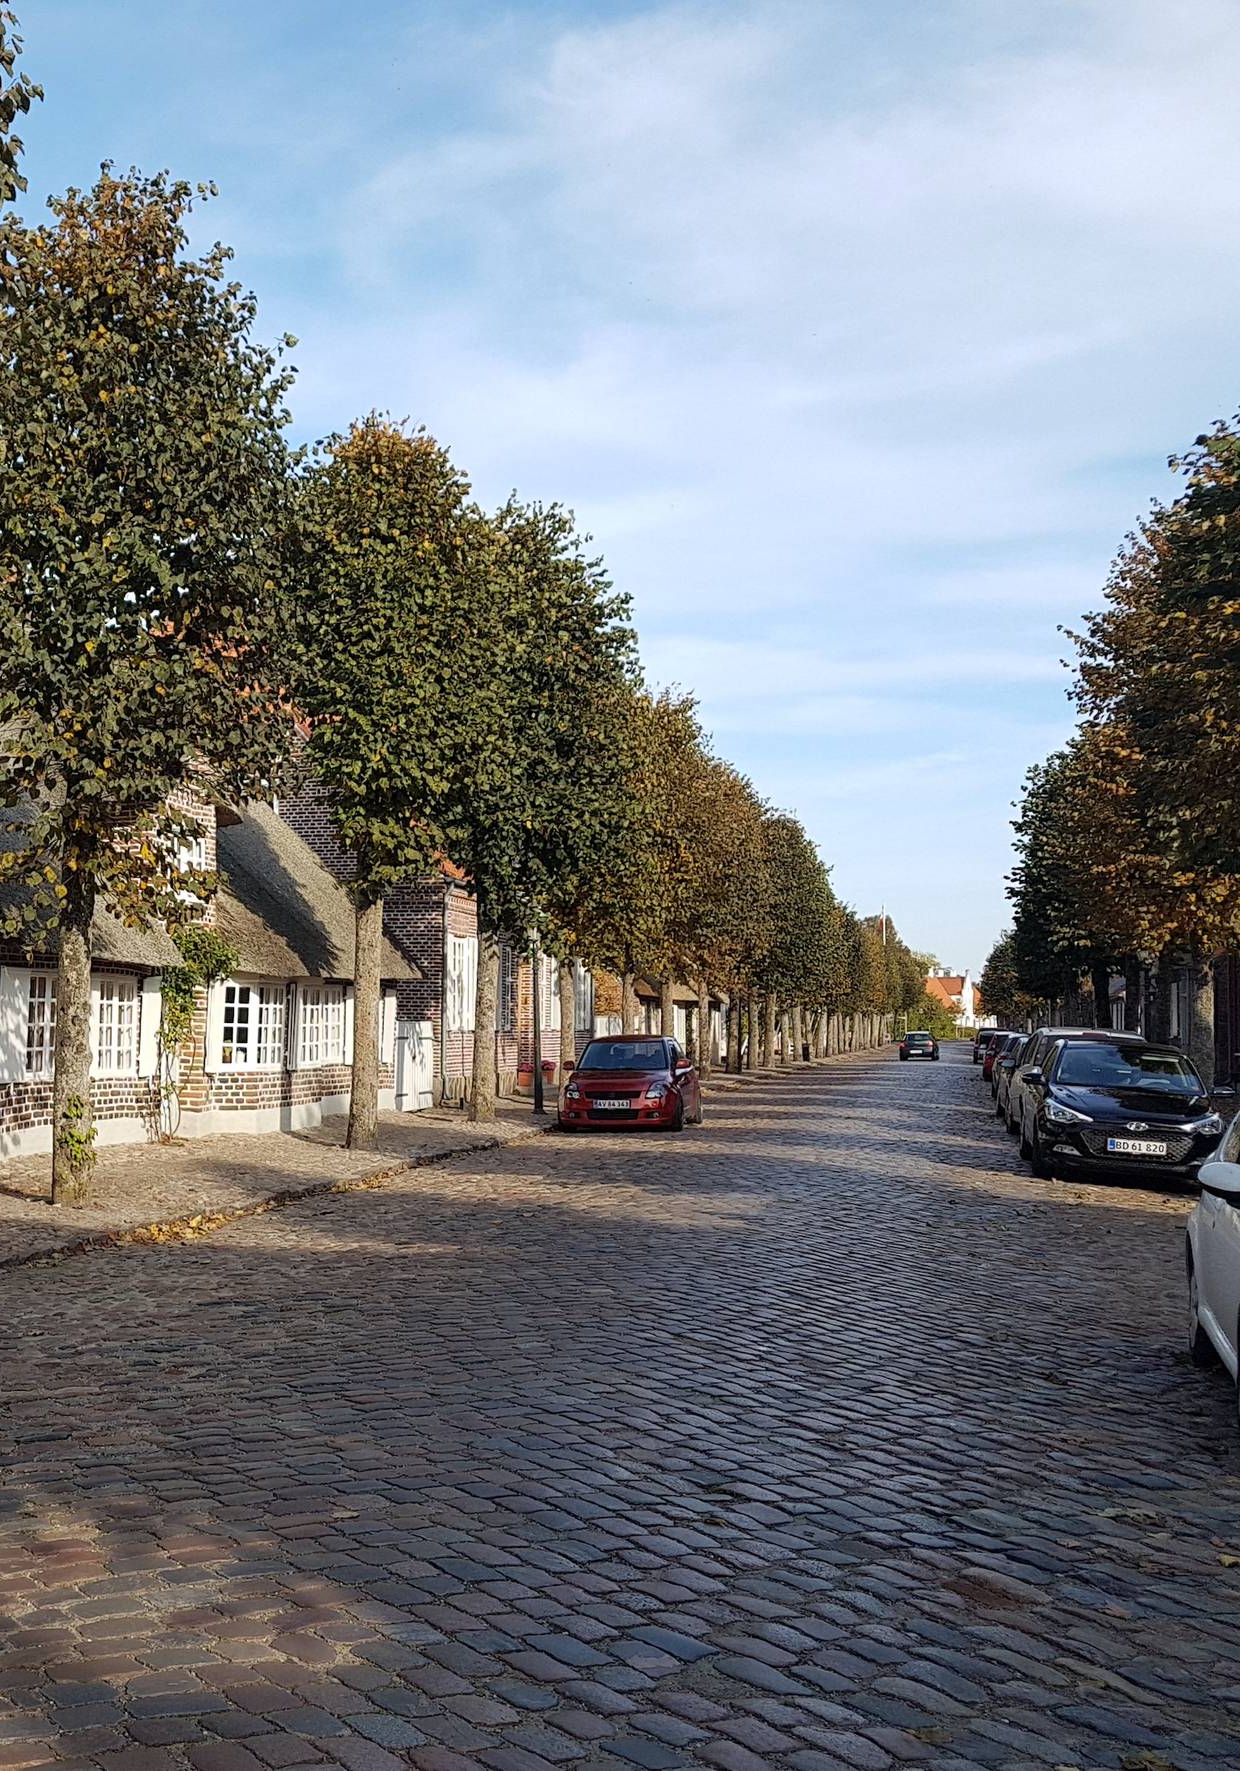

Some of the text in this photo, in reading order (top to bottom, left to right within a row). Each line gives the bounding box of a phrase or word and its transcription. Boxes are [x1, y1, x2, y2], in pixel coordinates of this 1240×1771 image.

[1115, 1141, 1165, 1153] BD 61 820
